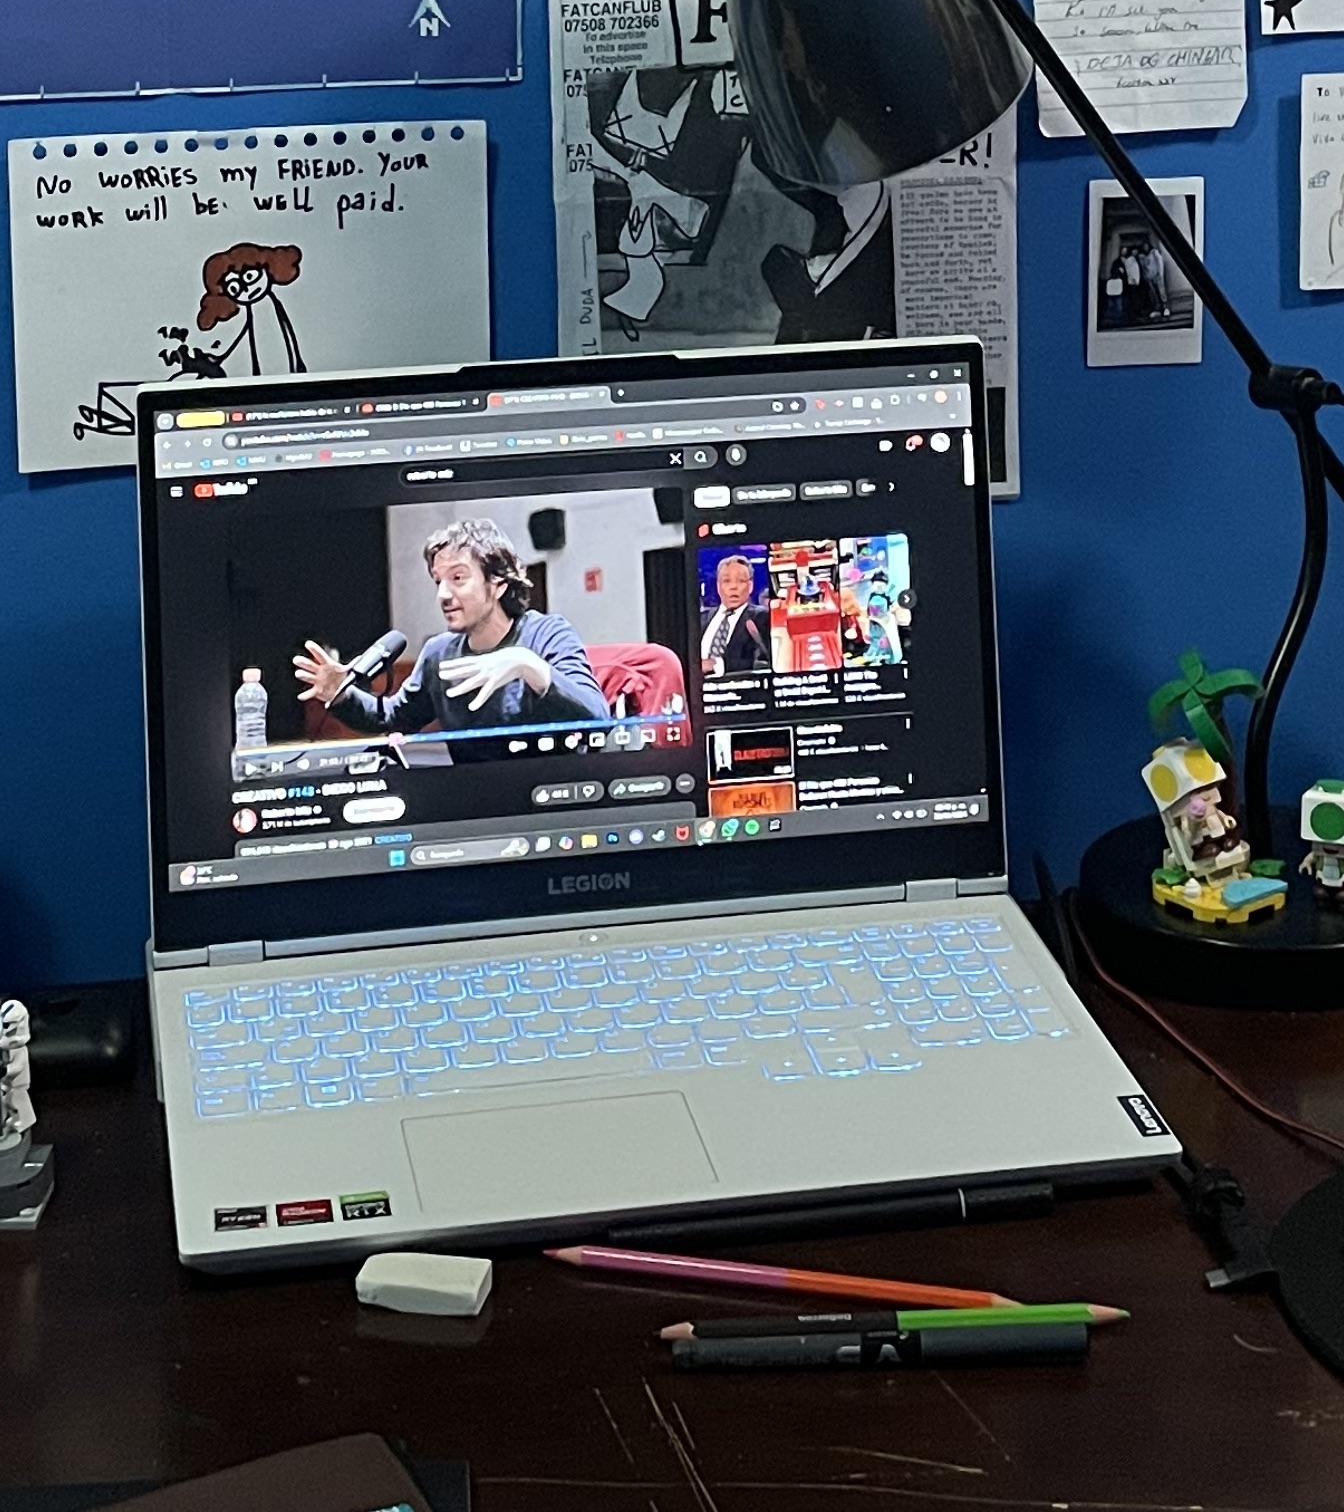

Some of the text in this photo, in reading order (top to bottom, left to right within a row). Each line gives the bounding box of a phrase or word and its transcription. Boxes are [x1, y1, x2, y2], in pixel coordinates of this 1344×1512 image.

[560, 0, 662, 18] FATCANFLUB
[564, 15, 660, 32] 07508 702366
[36, 175, 72, 199] No
[220, 165, 257, 190] my
[126, 196, 168, 222] will
[336, 183, 405, 230] paid.
[548, 872, 631, 896] LEGION
[345, 1201, 387, 1218] RTX
